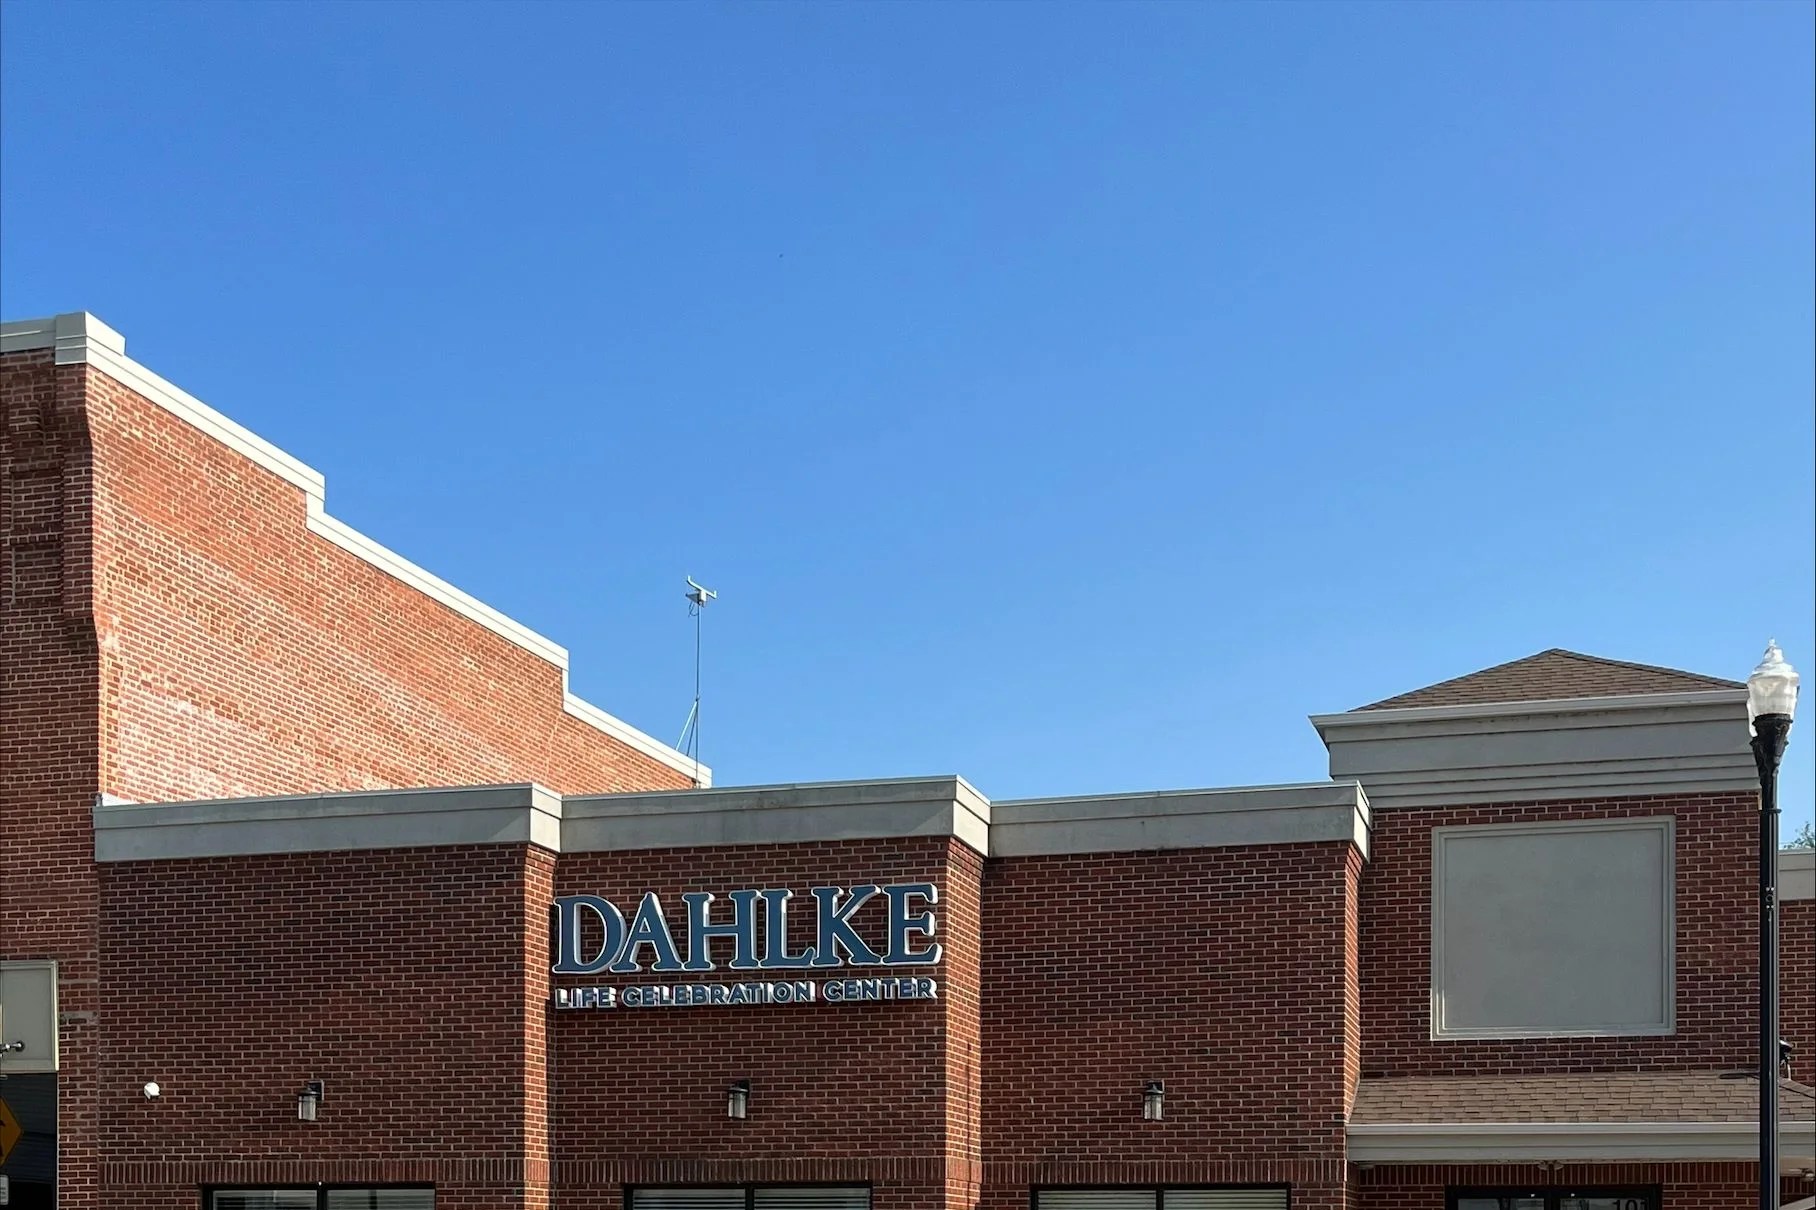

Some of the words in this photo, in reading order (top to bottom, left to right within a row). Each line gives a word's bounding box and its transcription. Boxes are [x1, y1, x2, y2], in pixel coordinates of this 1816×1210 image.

[552, 883, 943, 974] DAHLKE
[555, 986, 617, 1009] LIFE
[621, 981, 815, 1006] CELEBRATION
[823, 977, 938, 1001] CENTER
